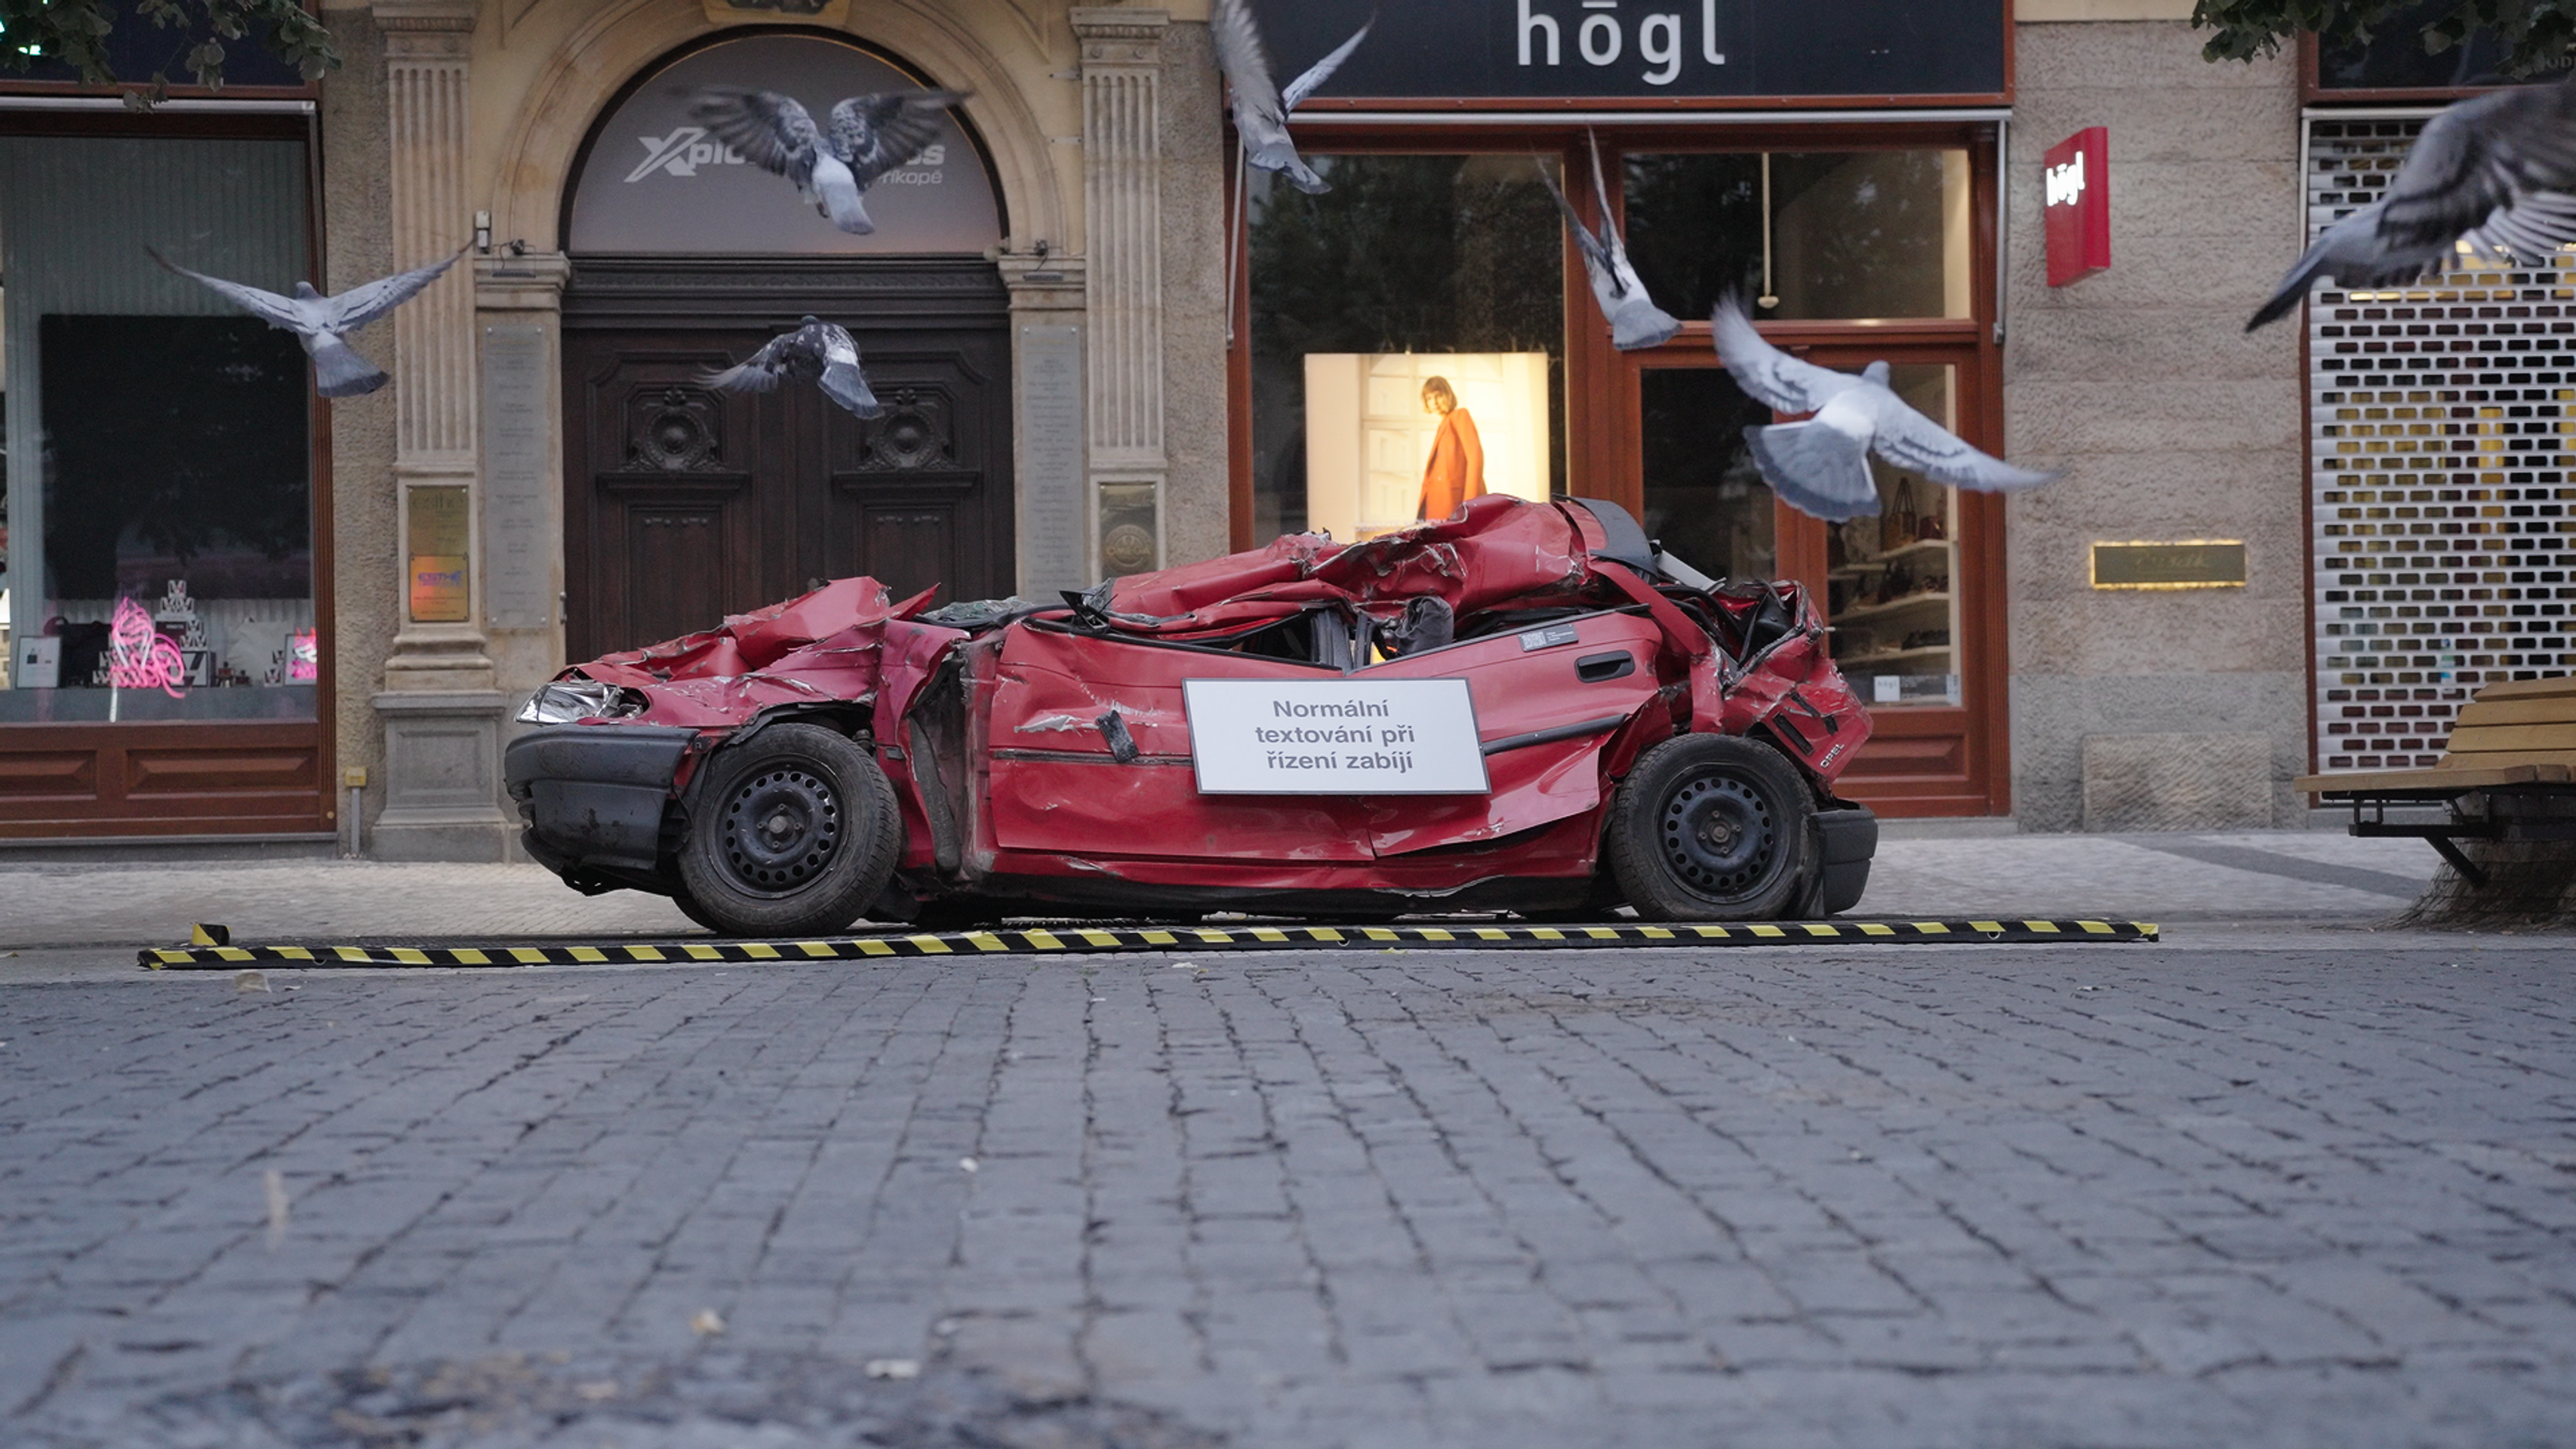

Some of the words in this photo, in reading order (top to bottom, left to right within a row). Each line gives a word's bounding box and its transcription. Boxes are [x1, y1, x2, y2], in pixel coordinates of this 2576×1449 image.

[1273, 699, 1390, 718] Normální
[1255, 725, 1373, 743] textování
[1382, 724, 1415, 746] při
[1266, 750, 1337, 770] řízení
[1346, 750, 1414, 774] zabíjí
[1820, 743, 1845, 769] OPEL
